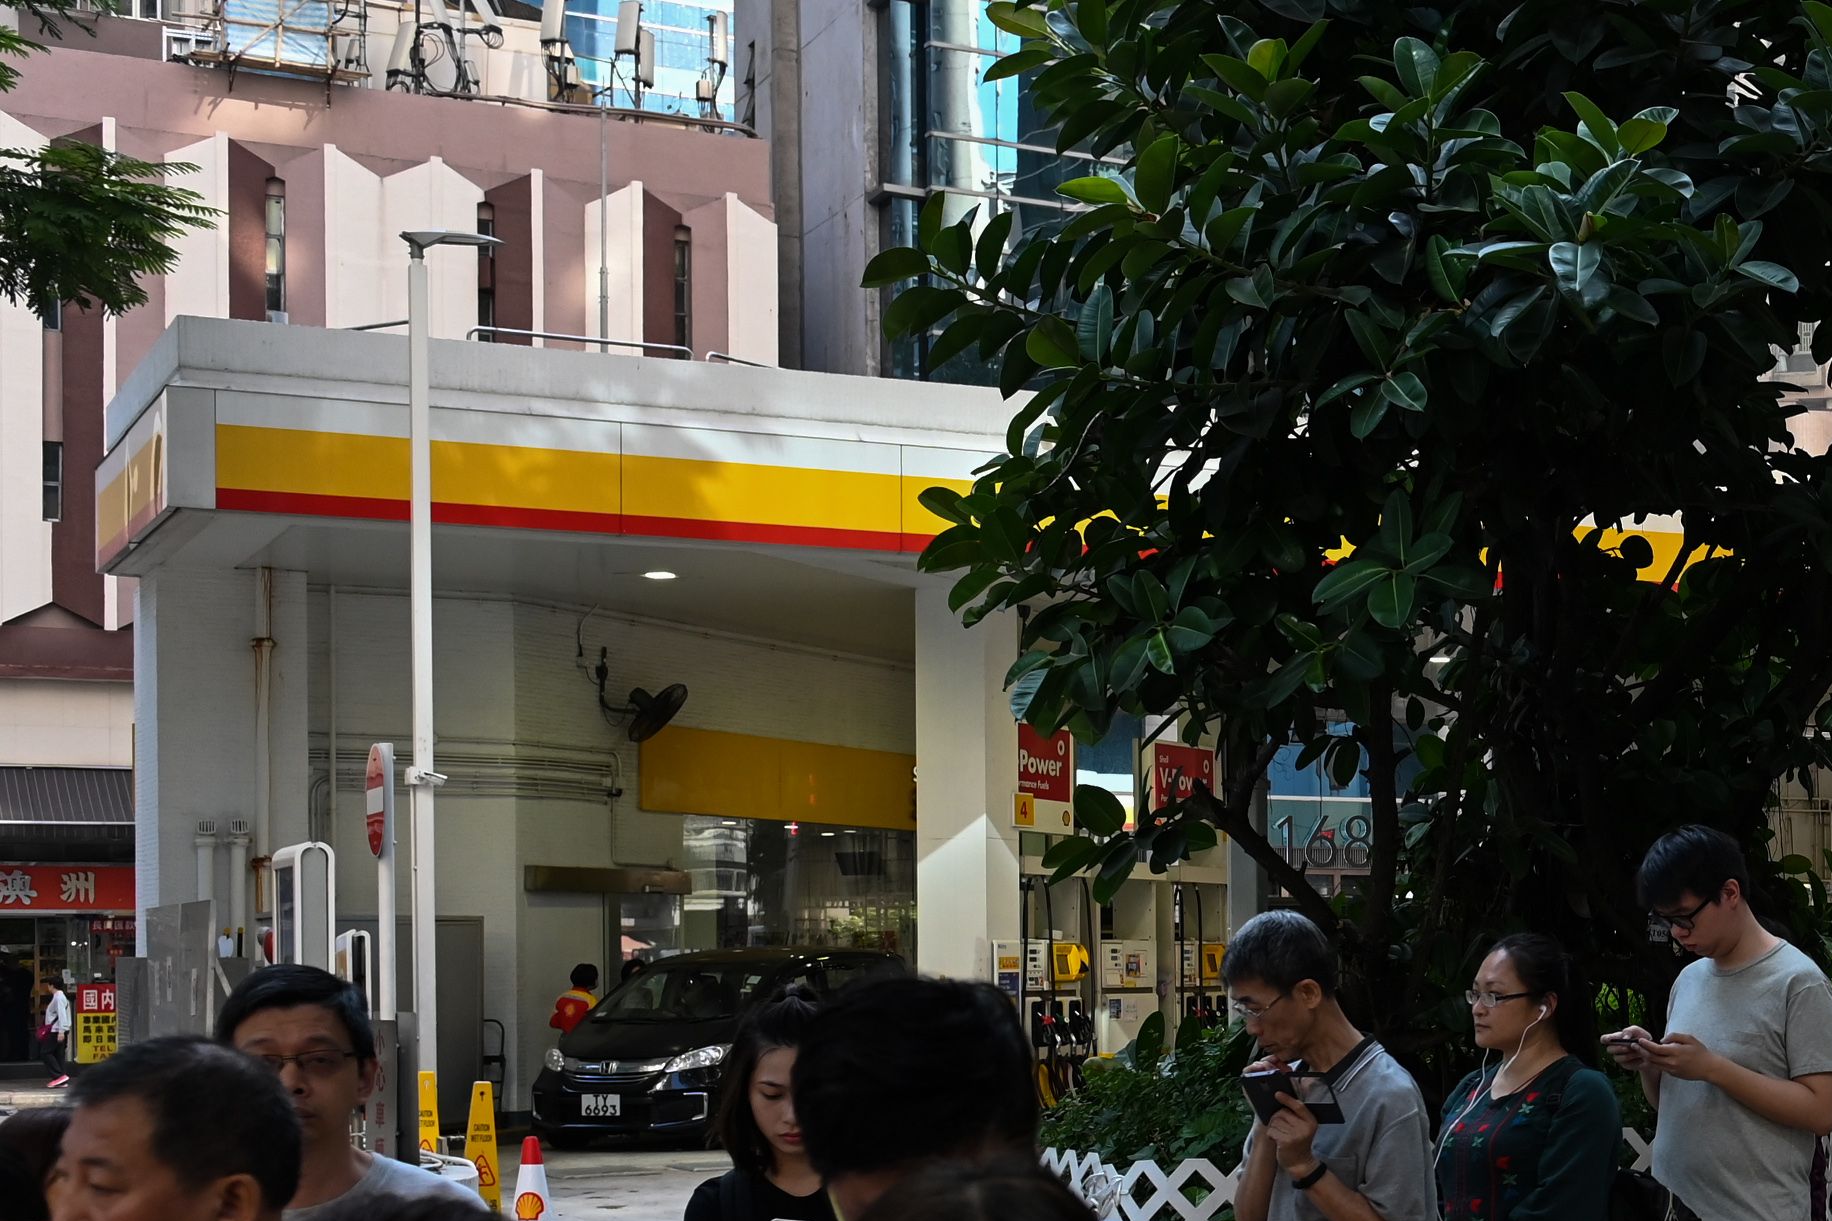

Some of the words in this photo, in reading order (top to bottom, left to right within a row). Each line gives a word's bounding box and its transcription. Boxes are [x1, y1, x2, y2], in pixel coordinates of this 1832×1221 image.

[1020, 801, 1028, 819] 4
[1272, 815, 1371, 867] 168
[593, 1094, 609, 1106] TY
[585, 1105, 617, 1116] 6693
